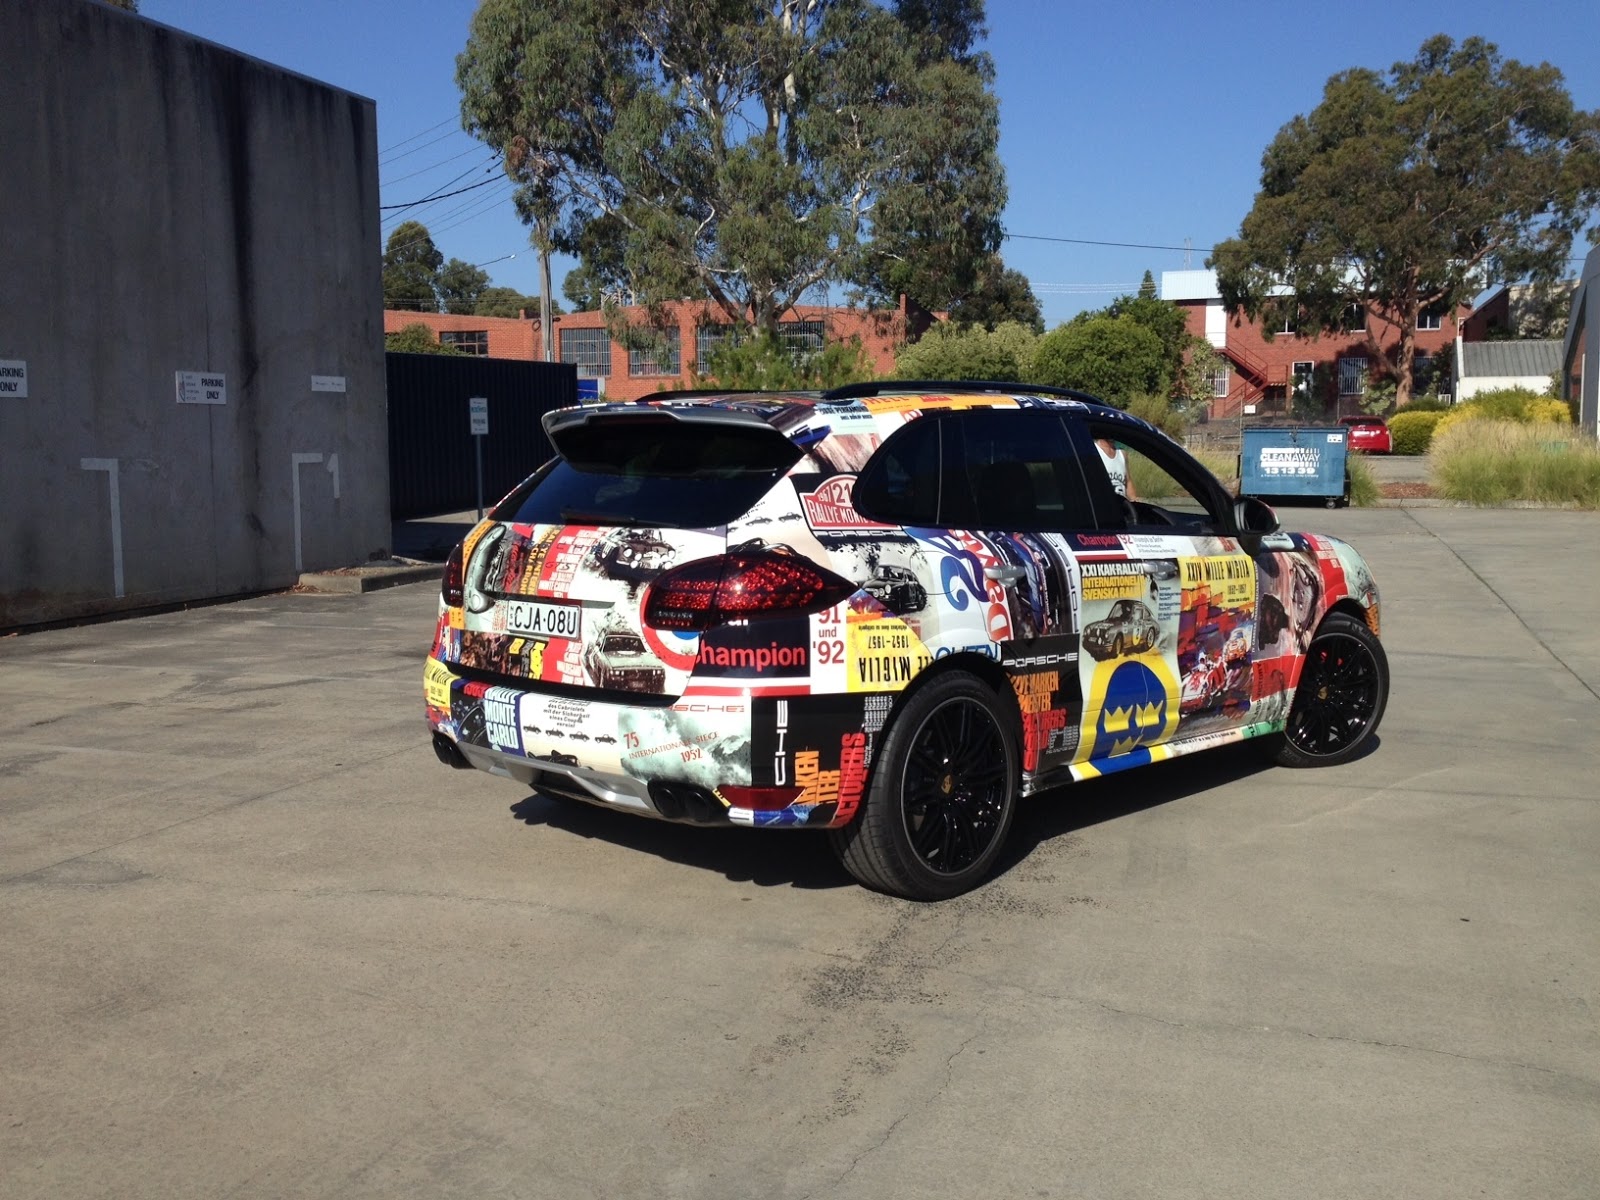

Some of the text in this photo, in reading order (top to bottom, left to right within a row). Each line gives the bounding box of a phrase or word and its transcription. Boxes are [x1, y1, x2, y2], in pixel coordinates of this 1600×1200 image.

[0, 381, 17, 391] ONLY
[201, 378, 224, 387] PARKING
[206, 390, 219, 400] ONLY
[1260, 453, 1320, 462] CLEANAWAY
[1264, 467, 1279, 475] 13
[1280, 467, 1296, 475] 13
[807, 499, 869, 524] RALLYE MON
[813, 530, 908, 538] PORSCHE
[1077, 533, 1120, 547] Champion
[1080, 564, 1097, 577] XXI
[1204, 561, 1225, 581] MILLE
[1225, 560, 1251, 580] MIGLIA
[1082, 587, 1119, 600] SVENSKA
[818, 626, 837, 638] und
[868, 635, 910, 649] 1952-1957
[696, 639, 807, 673] hampion
[1002, 652, 1079, 668] PORSCHE
[859, 656, 911, 682] MIGLIA
[484, 699, 517, 727] MONTE
[667, 704, 744, 713] SCHE
[486, 721, 520, 750] CARLO
[623, 731, 640, 750] 75
[628, 736, 692, 760] INTERNATIONALE
